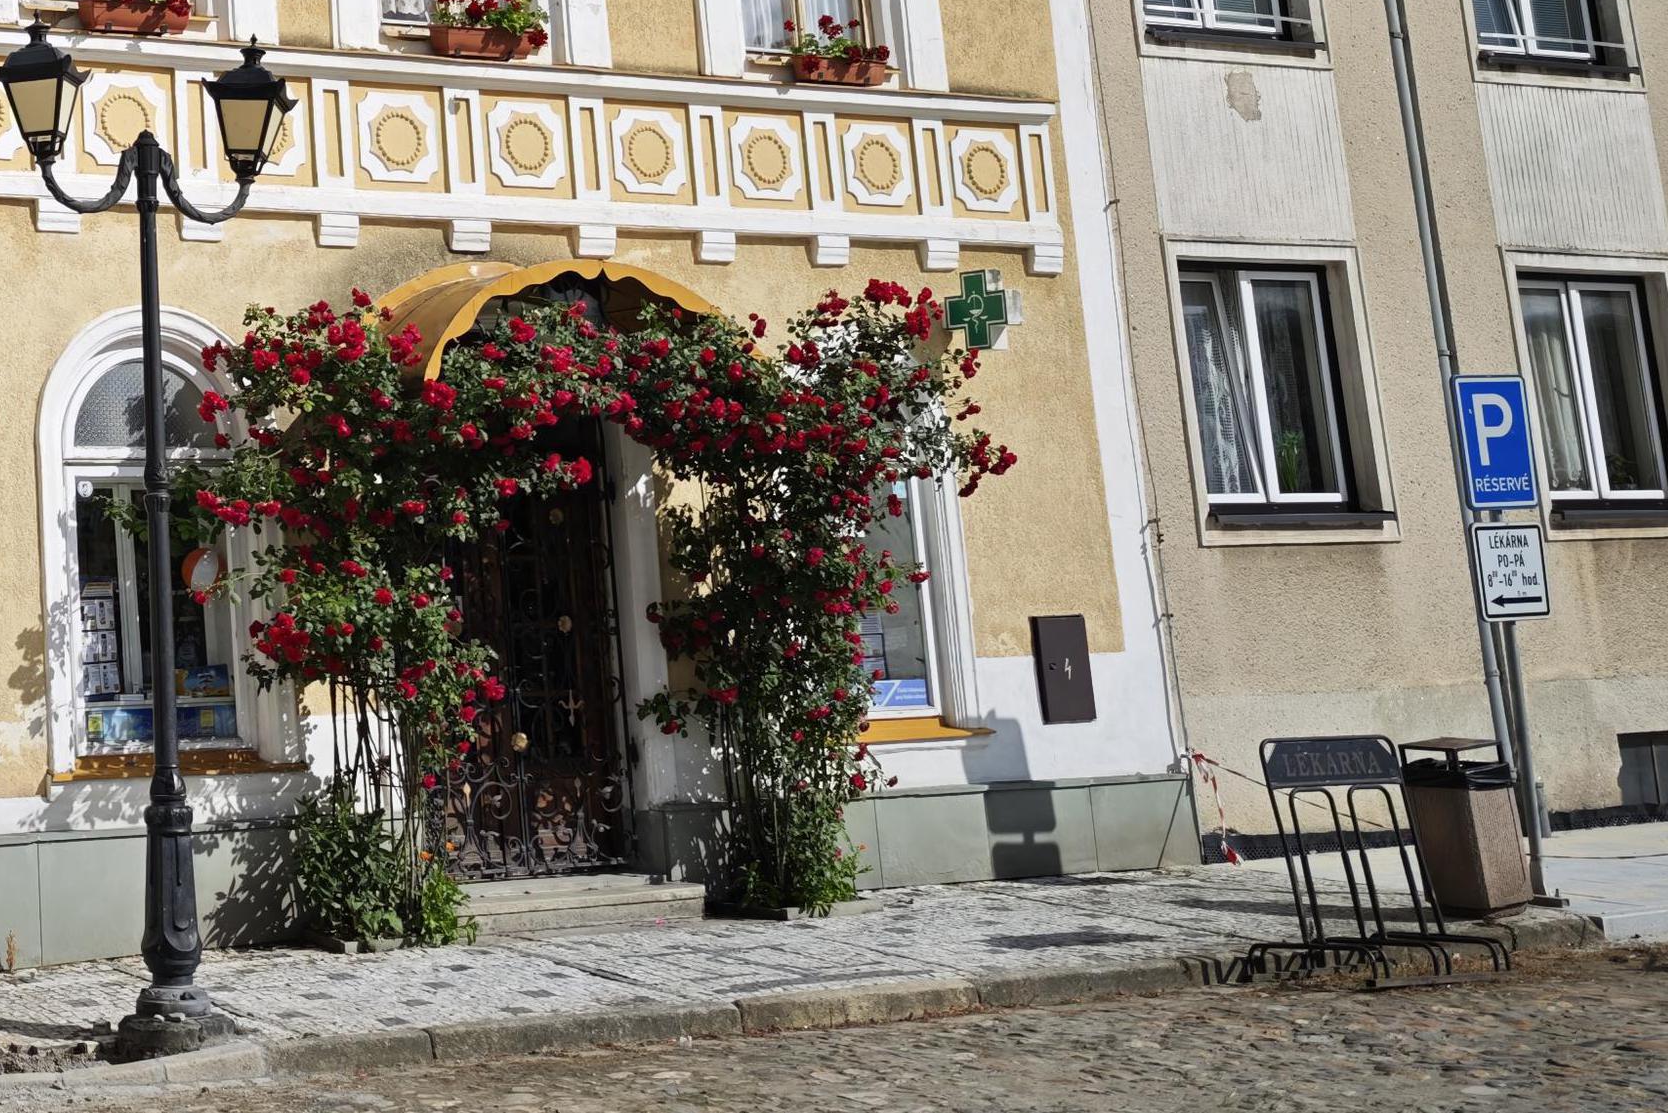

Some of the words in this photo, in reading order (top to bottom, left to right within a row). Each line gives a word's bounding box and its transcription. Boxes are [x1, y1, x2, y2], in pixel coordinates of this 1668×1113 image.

[1472, 393, 1513, 466] P
[1475, 473, 1530, 492] RÉSERVÉ
[1488, 531, 1529, 549] LÉKÁRNA
[1497, 550, 1525, 568] PO-PÁ
[1521, 572, 1541, 586] hod.
[1284, 745, 1382, 777] LÉKÁRNA
